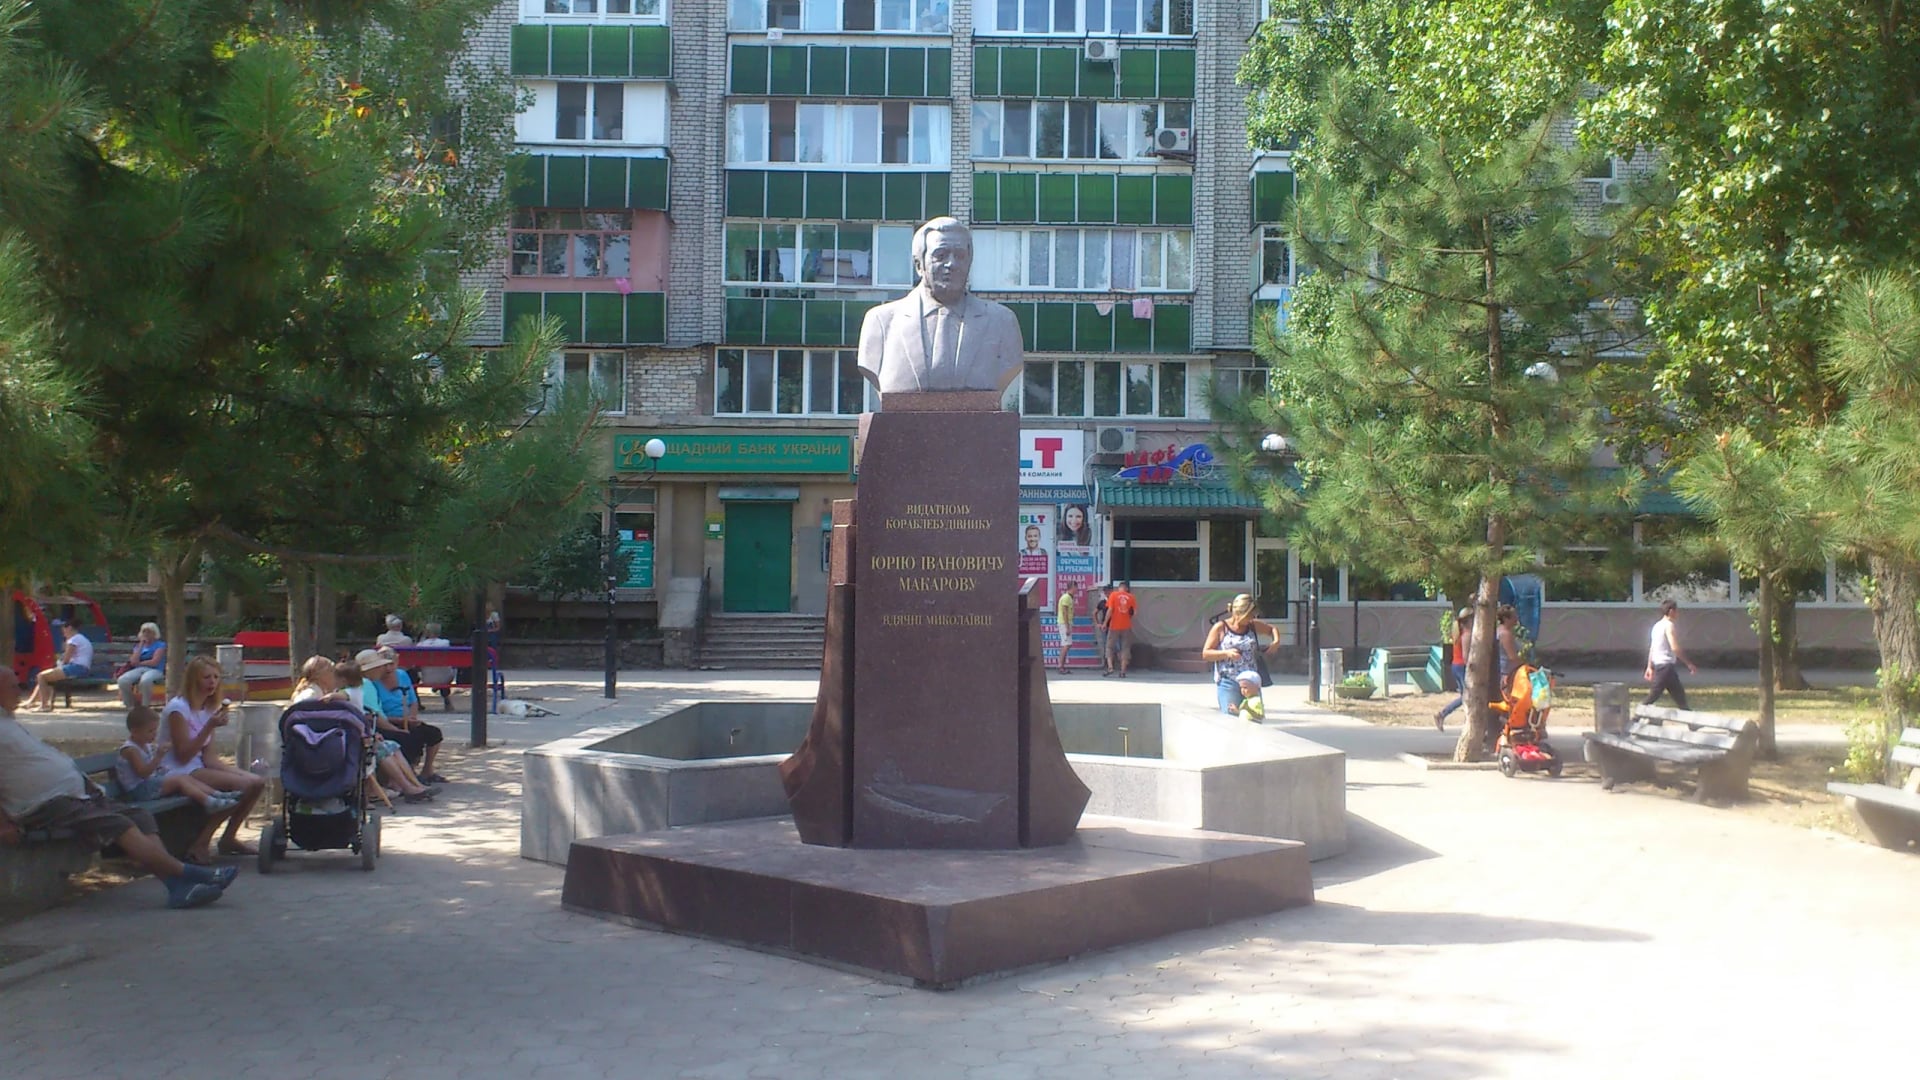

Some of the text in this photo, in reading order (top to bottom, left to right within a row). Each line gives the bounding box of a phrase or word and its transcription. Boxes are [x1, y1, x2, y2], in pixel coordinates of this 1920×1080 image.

[738, 442, 776, 455] БАНК
[782, 440, 842, 456] УКРАЇНИ
[1124, 443, 1176, 468] КАФЕ
[1053, 489, 1088, 499] ЯЗЫКОВ
[906, 504, 971, 516] ВИДАТНОМУ
[885, 519, 992, 530] КОРАБЛЕБУДІВНИКУ
[1019, 515, 1046, 524] BLT
[871, 556, 1005, 571] ЮРІЮ ІВАНОВИЧУ
[899, 577, 977, 591] МАКАРОВУ
[883, 615, 922, 626] ВДЯЧНІ
